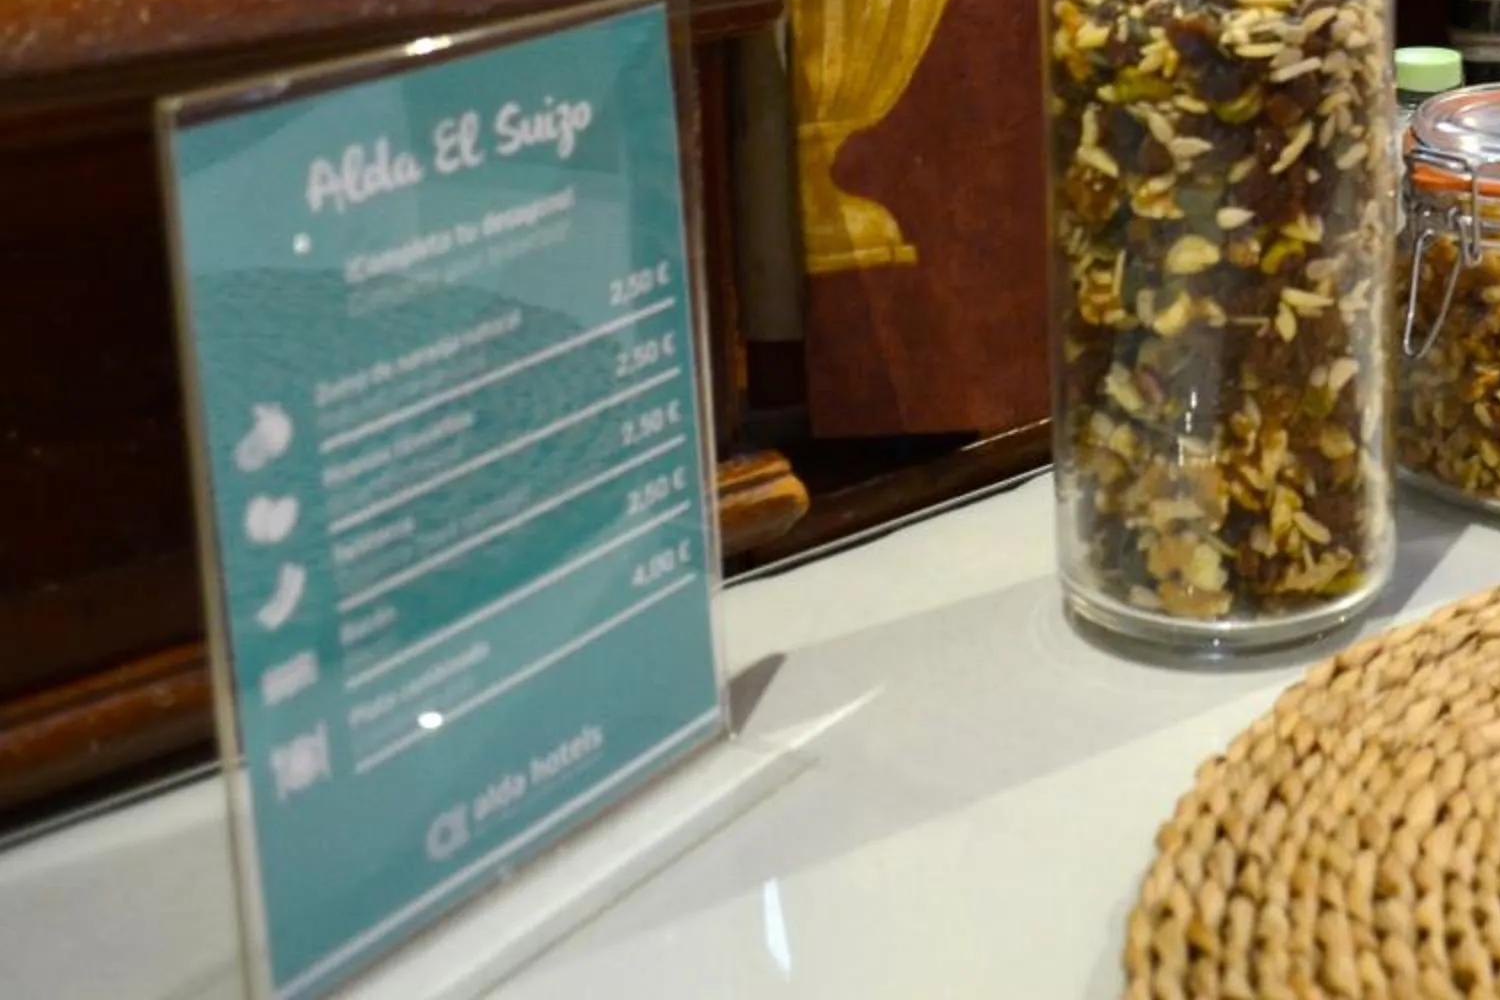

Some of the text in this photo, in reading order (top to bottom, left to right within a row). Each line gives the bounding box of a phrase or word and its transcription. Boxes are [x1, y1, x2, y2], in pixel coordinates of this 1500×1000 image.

[306, 95, 593, 213] Alda El Suizo
